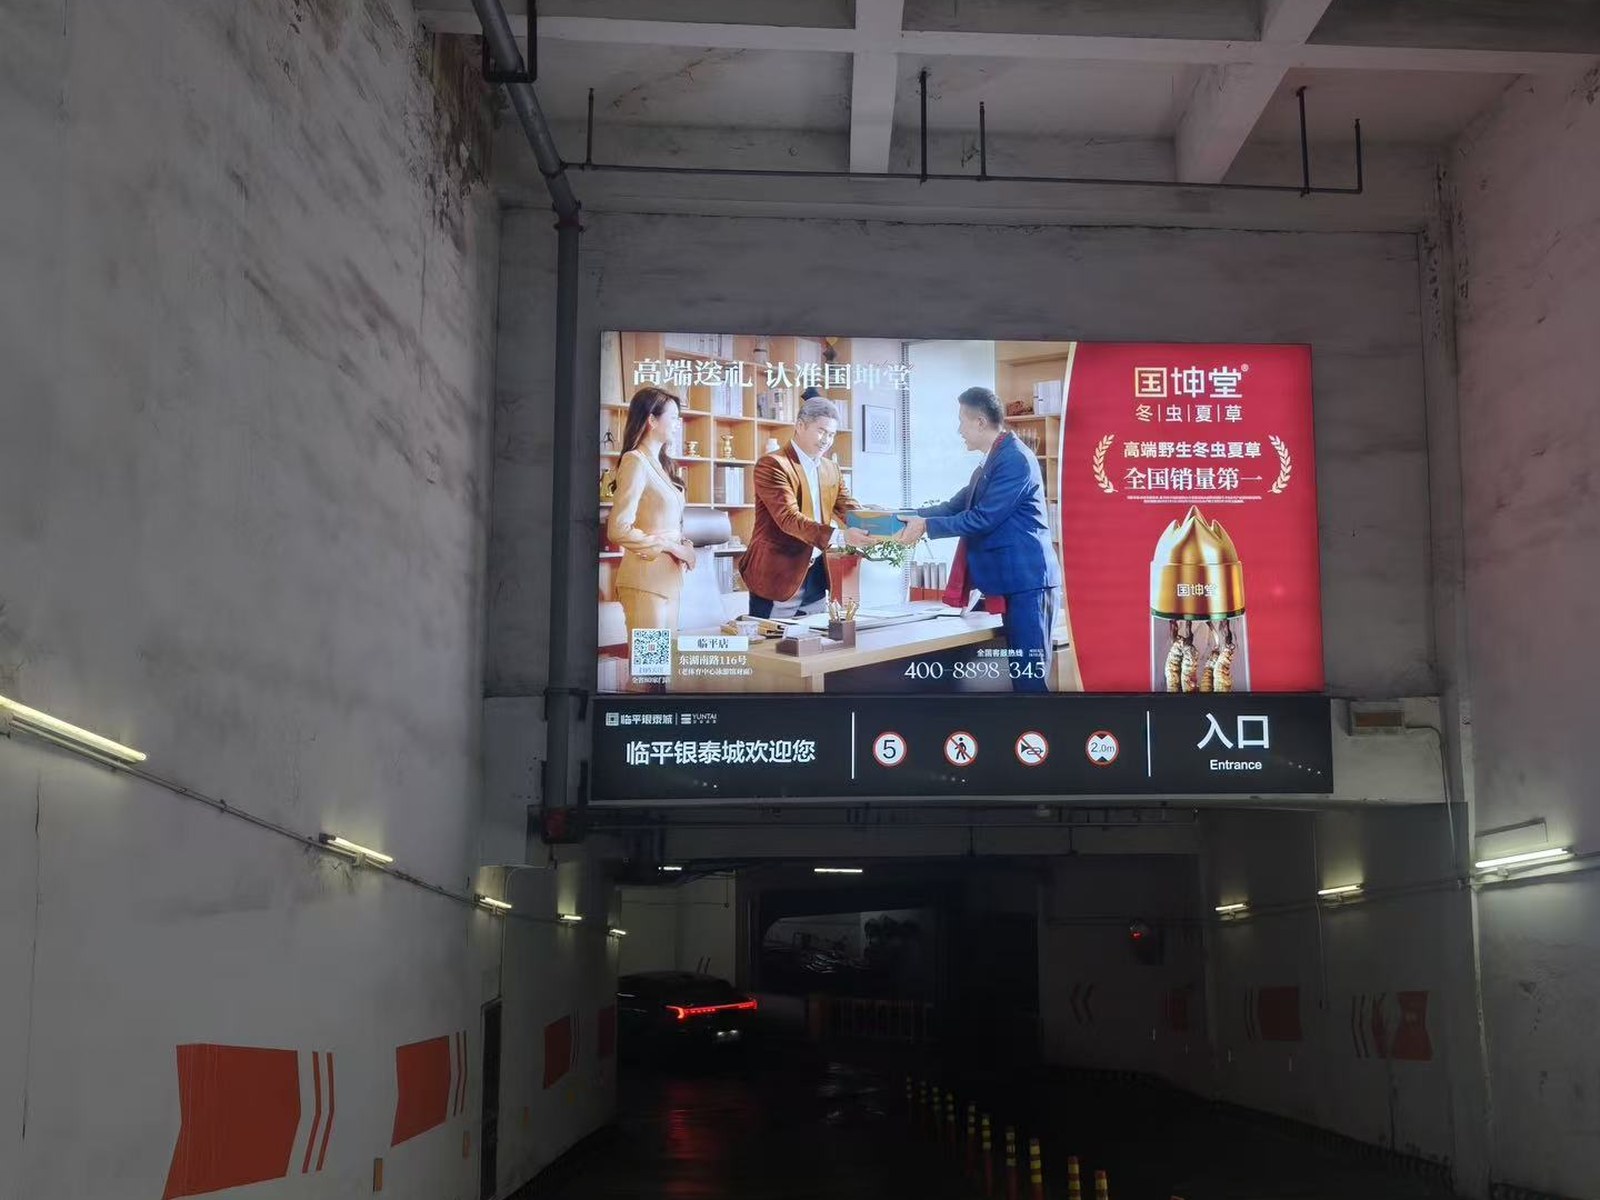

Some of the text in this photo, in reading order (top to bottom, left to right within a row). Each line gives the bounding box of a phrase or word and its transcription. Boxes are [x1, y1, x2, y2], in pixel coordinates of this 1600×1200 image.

[633, 358, 914, 391] 高端送礼 认准国坤堂
[1134, 365, 1243, 399] 国坤堂
[1123, 441, 1261, 459] 高端野生冬虫夏草
[1123, 467, 1263, 490] 全国销量第一
[1177, 583, 1216, 597] 国坤堂
[697, 638, 729, 649] 临平店
[679, 655, 747, 666] 东湖南路116号
[620, 714, 673, 725] 临平银泰城
[1197, 712, 1270, 749] 入口
[626, 739, 816, 765] 临平银泰城欢迎您
[883, 740, 896, 759] 5
[1209, 759, 1262, 770] Entrance
